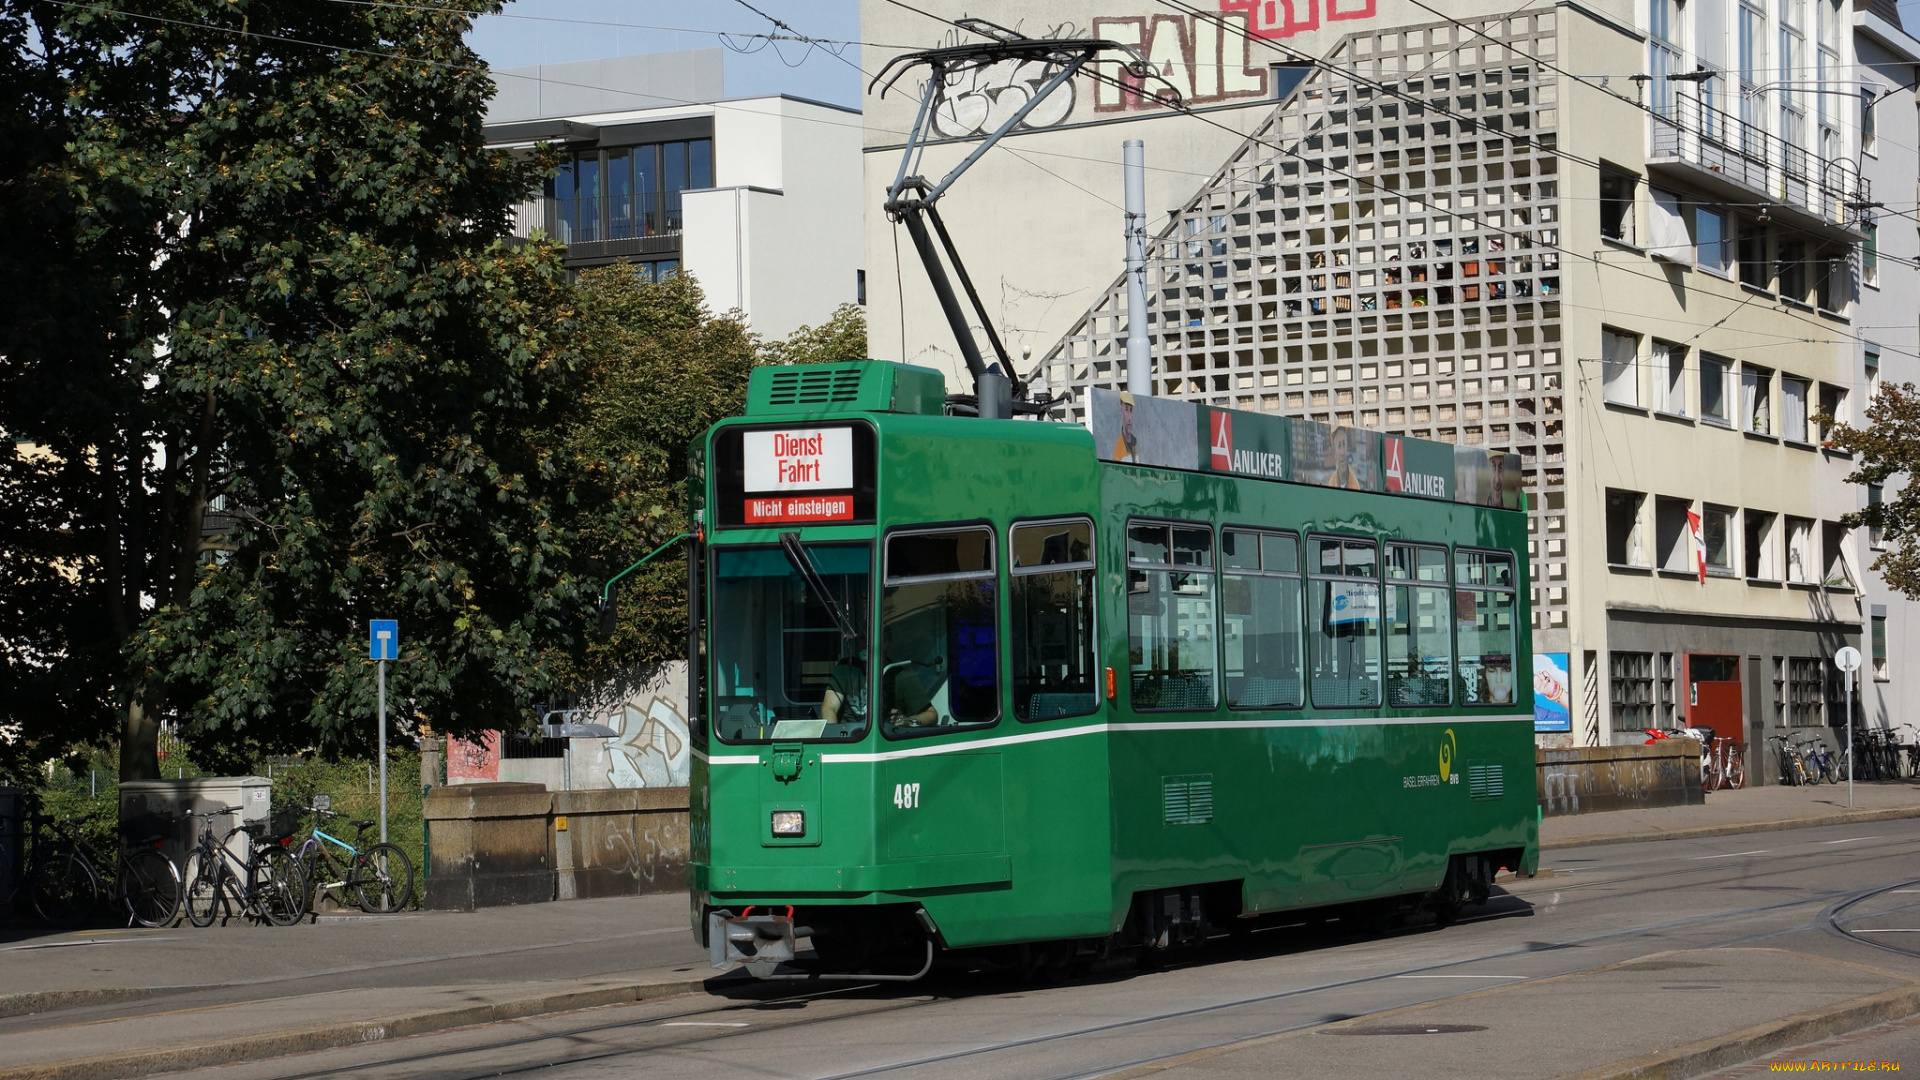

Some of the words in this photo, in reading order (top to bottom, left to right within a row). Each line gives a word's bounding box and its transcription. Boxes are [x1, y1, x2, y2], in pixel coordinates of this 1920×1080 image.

[774, 433, 822, 456] Dienst
[778, 459, 820, 483] Fahrt
[1232, 450, 1282, 477] ANLIKER
[1403, 472, 1445, 497] ANLIKER
[753, 501, 782, 517] Nicht
[788, 499, 845, 517] einsteigen
[1449, 773, 1459, 785] BVB
[893, 783, 920, 809] 487
